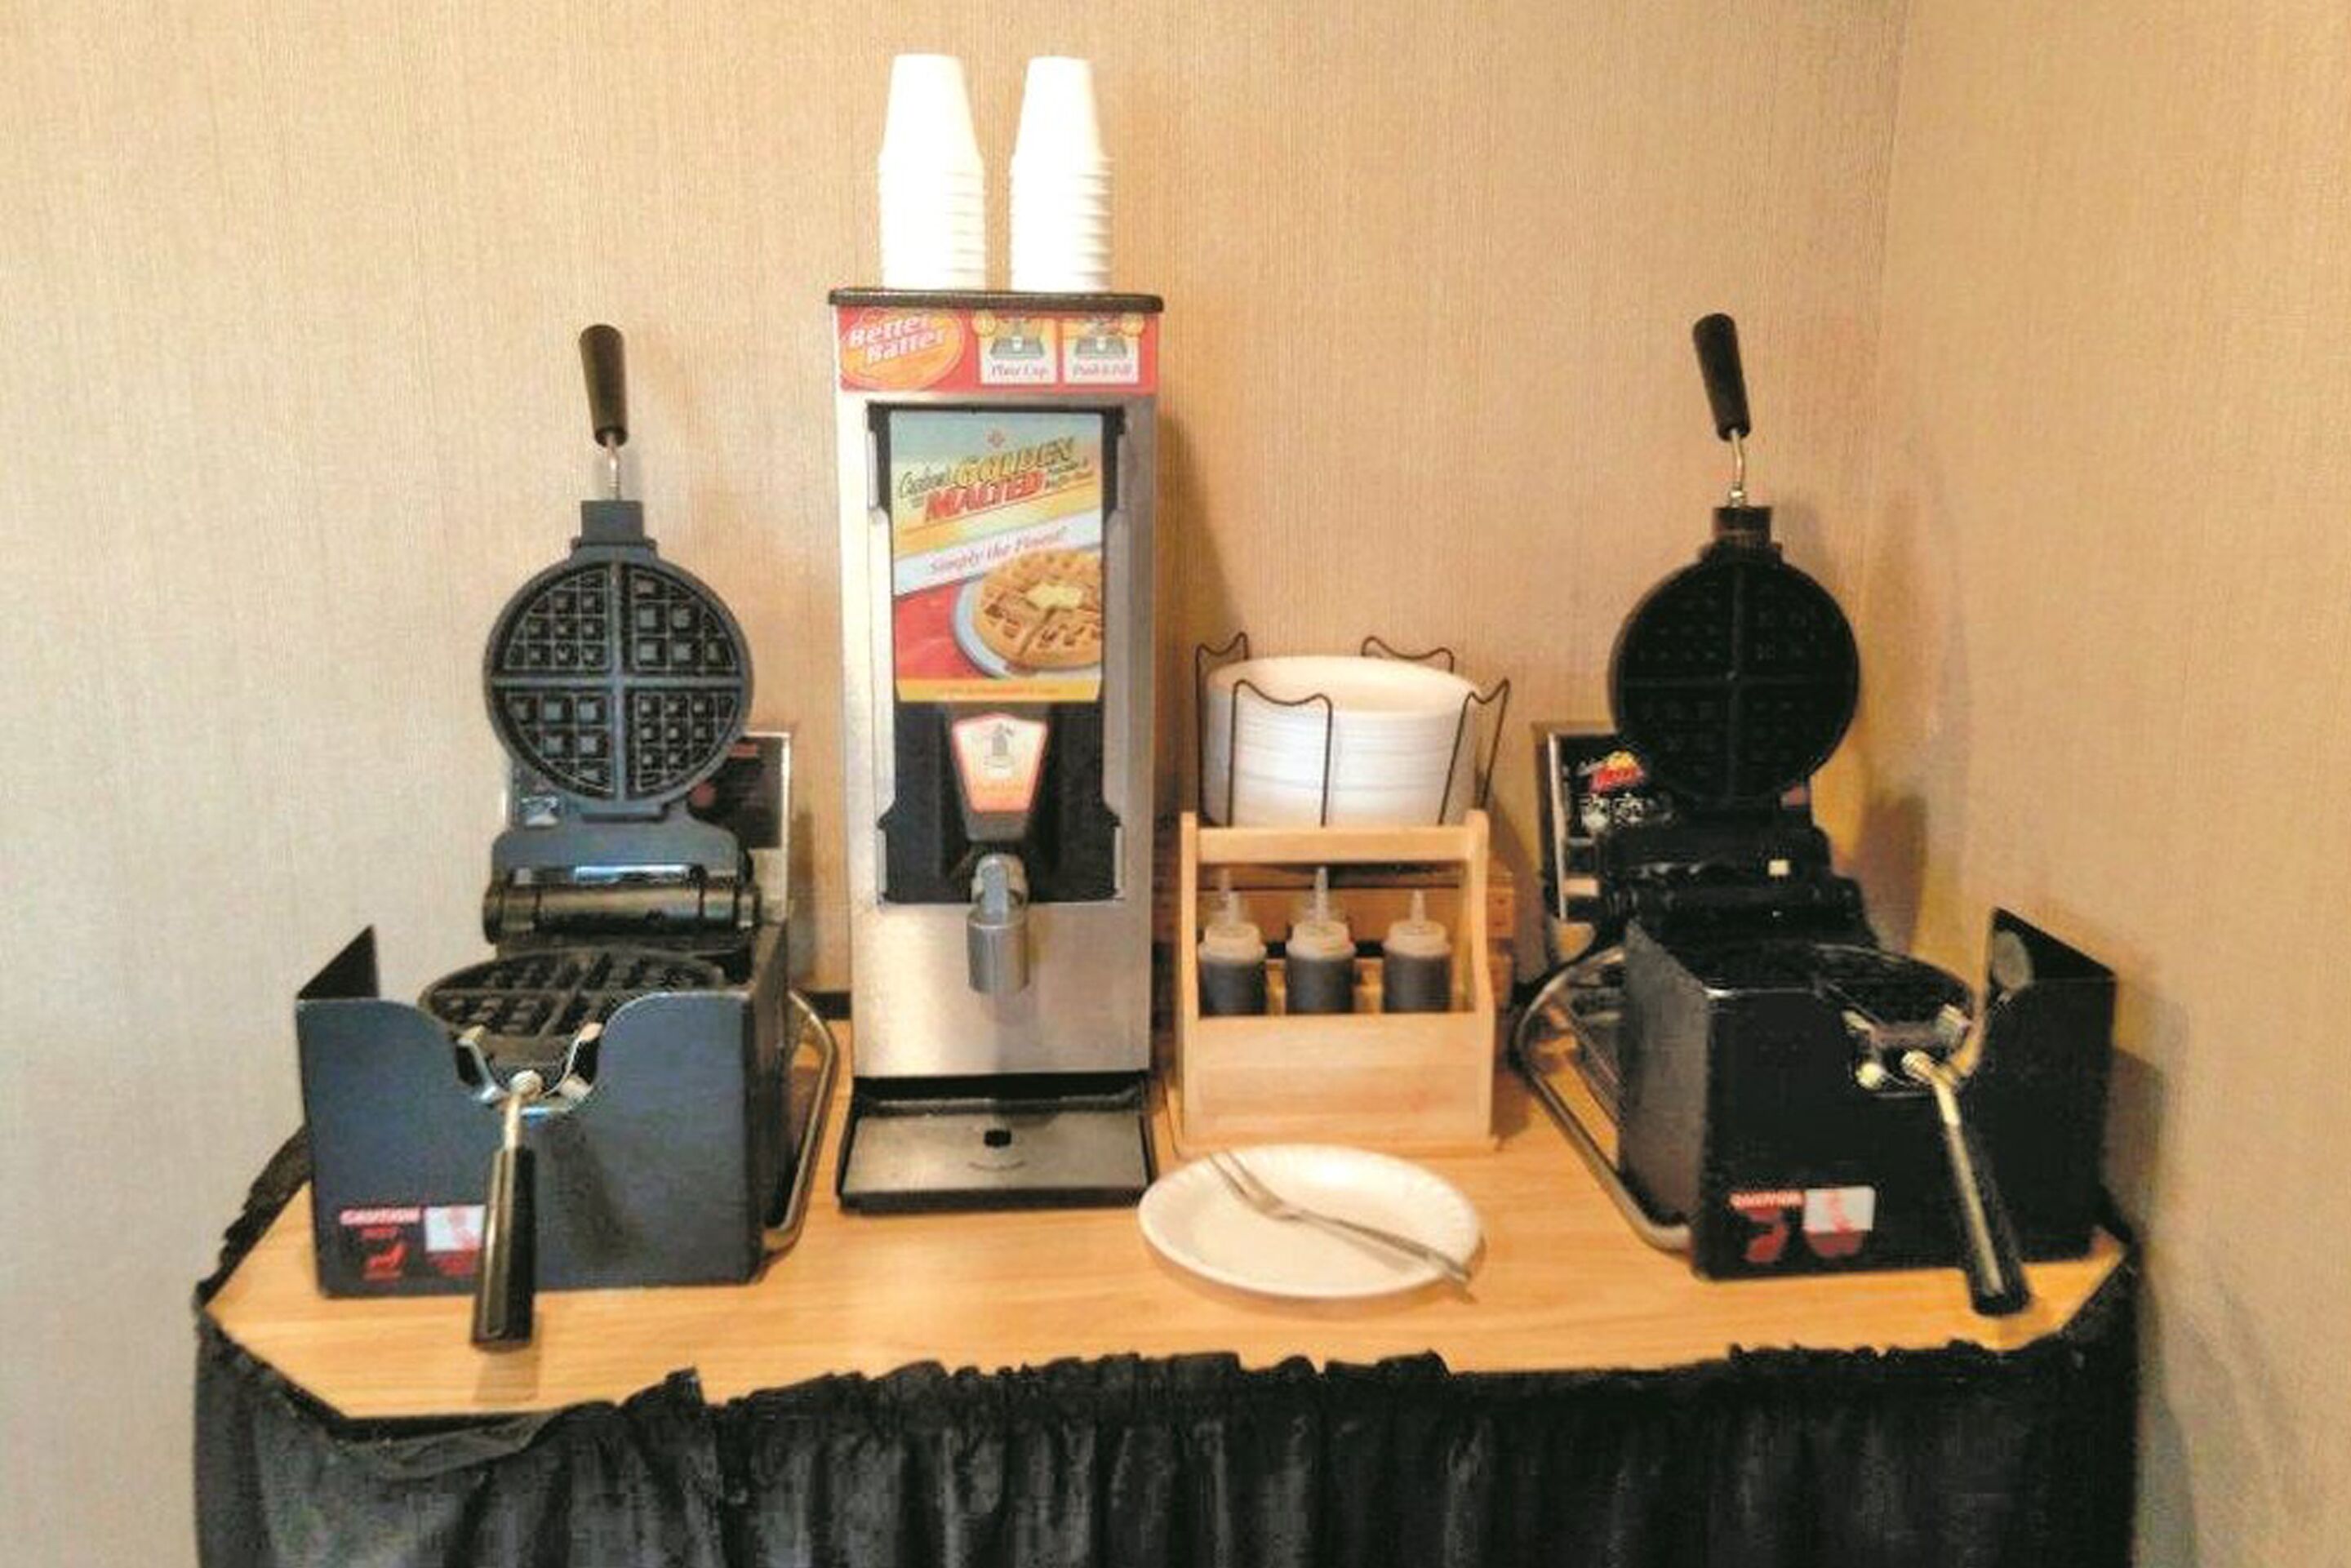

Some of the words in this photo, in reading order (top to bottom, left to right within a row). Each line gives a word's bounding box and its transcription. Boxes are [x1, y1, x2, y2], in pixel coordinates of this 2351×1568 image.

[849, 314, 929, 348] Better
[868, 330, 944, 365] Batter
[925, 470, 1046, 523] MALTED
